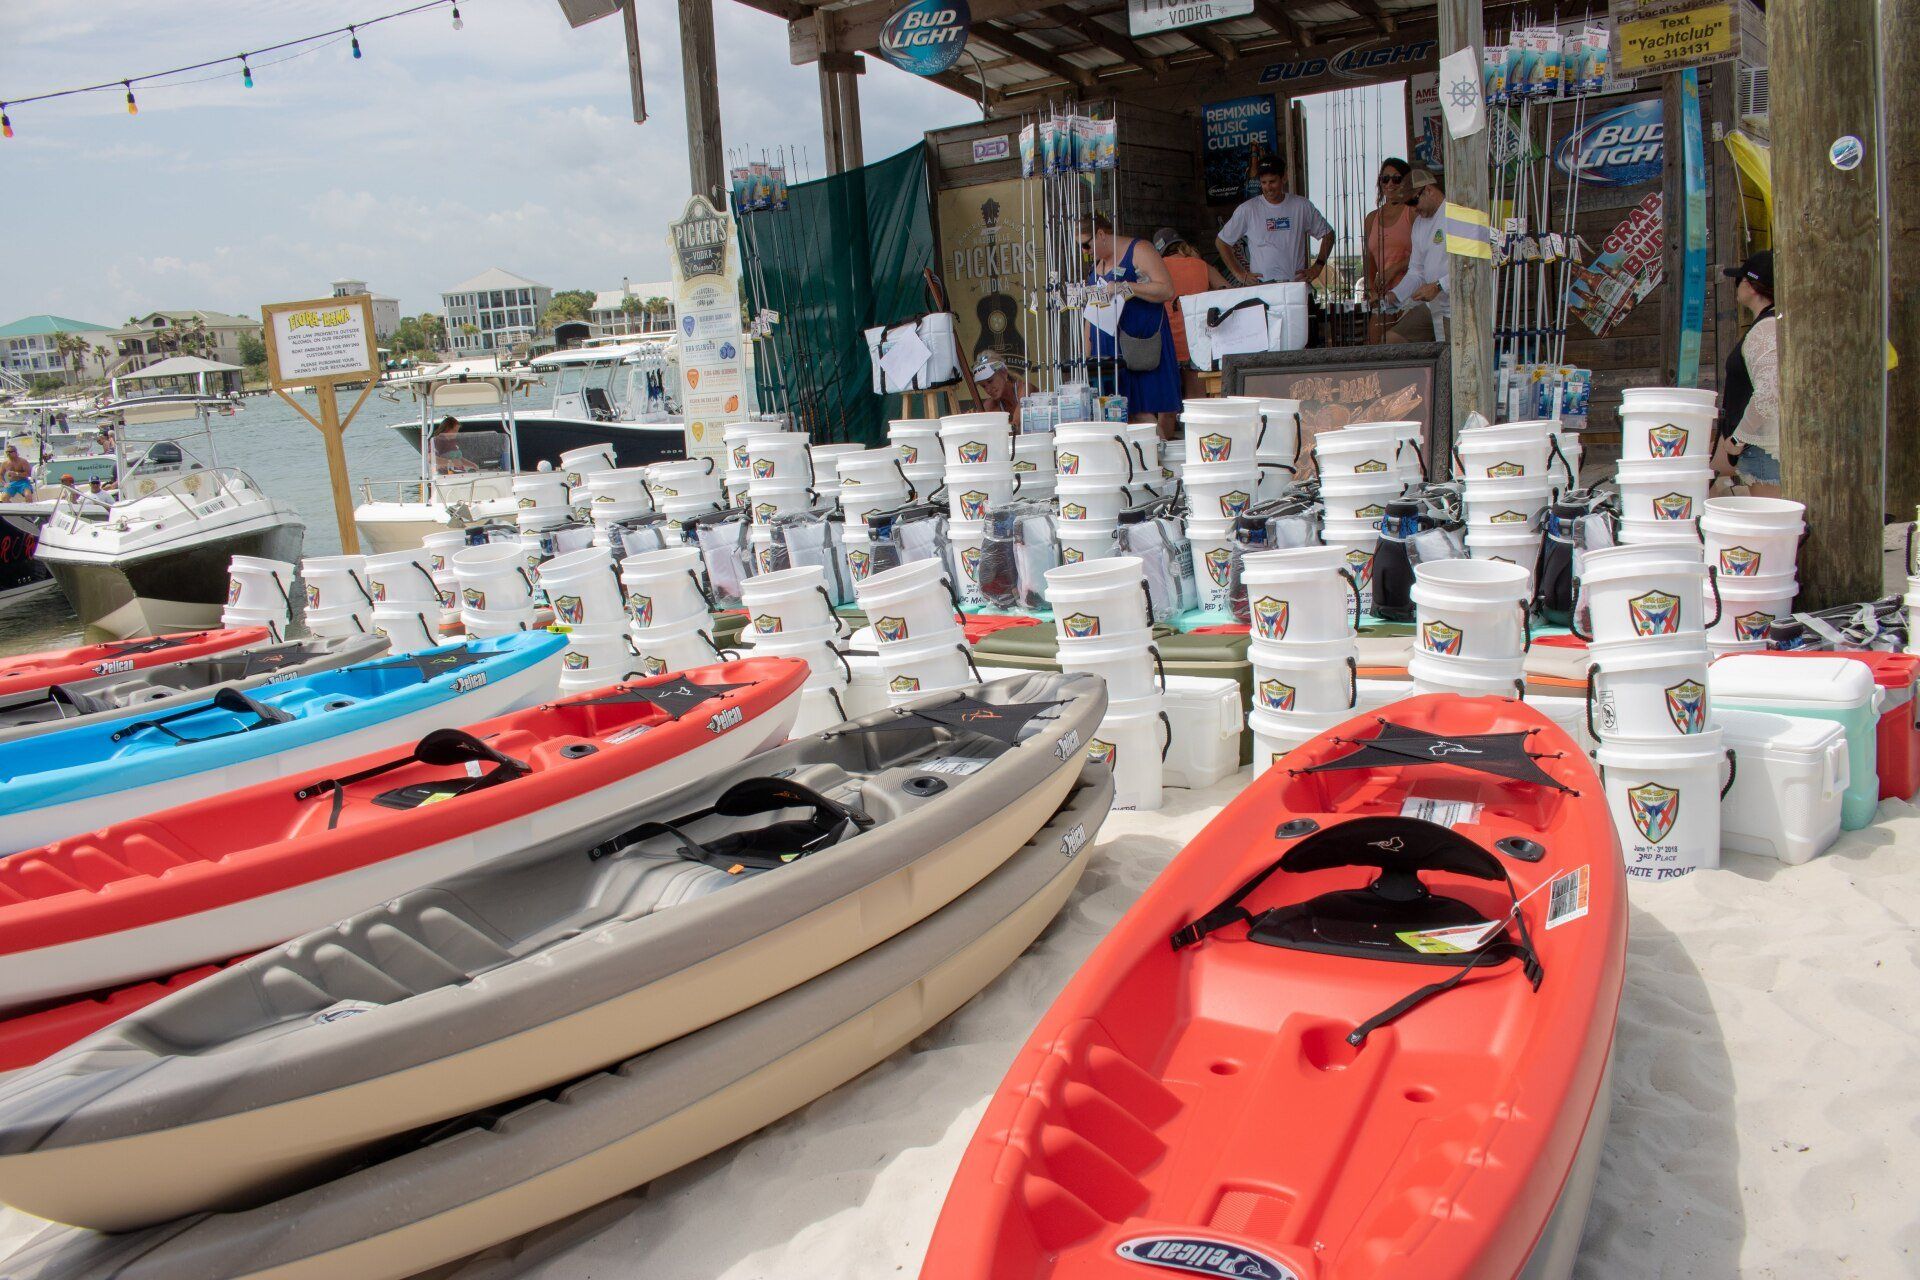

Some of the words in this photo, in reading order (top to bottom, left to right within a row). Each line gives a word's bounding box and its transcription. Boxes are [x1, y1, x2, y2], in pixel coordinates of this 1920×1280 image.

[903, 9, 957, 30] BUD
[1169, 4, 1213, 25] VODKA
[1617, 15, 1635, 23] For
[1638, 5, 1679, 20] Local's
[1660, 14, 1691, 29] Text
[891, 25, 963, 48] LIGHT
[1628, 21, 1722, 50] "Yachtclub"
[1258, 57, 1329, 84] BUD
[1341, 39, 1437, 71] LIGHT
[1642, 54, 1656, 63] to
[1664, 41, 1710, 59] 313131
[1617, 68, 1647, 79] Message
[1701, 55, 1716, 63] May
[1718, 51, 1738, 62] Apply
[1415, 87, 1439, 98] AME
[1206, 101, 1271, 122] REMIXING
[1207, 119, 1249, 136] MUSIC
[1594, 122, 1663, 149] BUD
[974, 140, 1009, 158] DED
[1207, 131, 1268, 150] CULTURE
[1577, 143, 1663, 169] LIGH
[676, 218, 728, 248] PICKERS
[1603, 192, 1663, 254] GRAB
[1623, 213, 1662, 254] SOME
[692, 249, 713, 261] VODKA
[953, 240, 1038, 281] PICKERS
[1622, 228, 1663, 277] BUD
[979, 277, 1011, 294] VODKA
[288, 307, 351, 332] FLORA-BAMA
[77, 463, 112, 471] NauticStar
[101, 659, 134, 675] Pelican
[456, 671, 487, 694] Pelican
[710, 705, 743, 734] Pelican
[1057, 728, 1081, 761] Pelican
[1062, 823, 1087, 858] Pelican
[1636, 853, 1653, 862] 3RD
[1657, 866, 1696, 880] TROUT
[1147, 1241, 1249, 1274] Pelican
